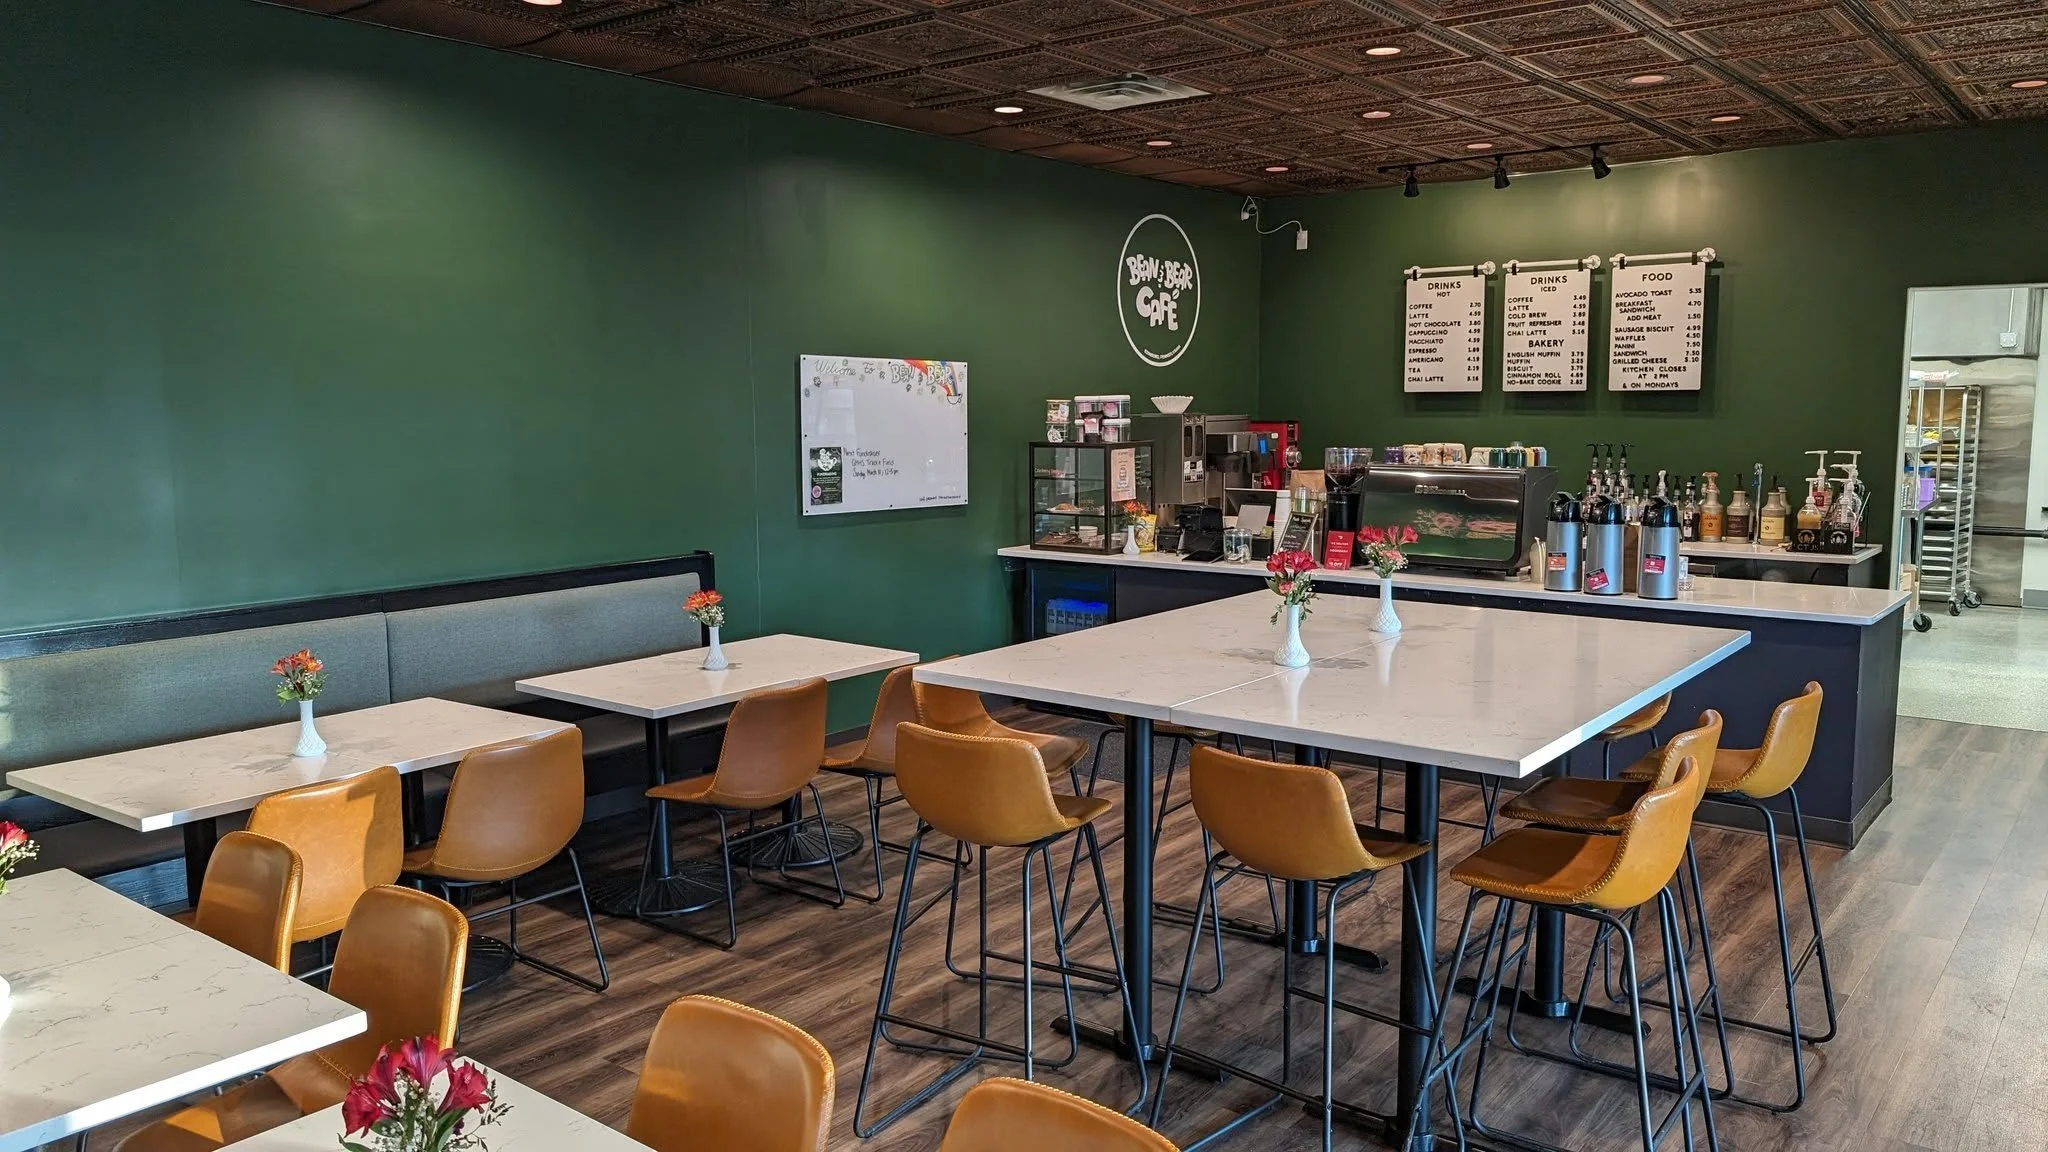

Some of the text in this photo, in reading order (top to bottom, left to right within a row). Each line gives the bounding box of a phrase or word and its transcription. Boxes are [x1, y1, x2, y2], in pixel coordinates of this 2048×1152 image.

[1126, 254, 1159, 286] BEAN
[1164, 260, 1193, 290] BEAR
[1531, 276, 1567, 284] DRINKS
[1642, 273, 1672, 282] FOOD
[1428, 282, 1461, 290] DRINKS
[1529, 339, 1564, 347] BAKERY
[814, 360, 856, 376] Welcome
